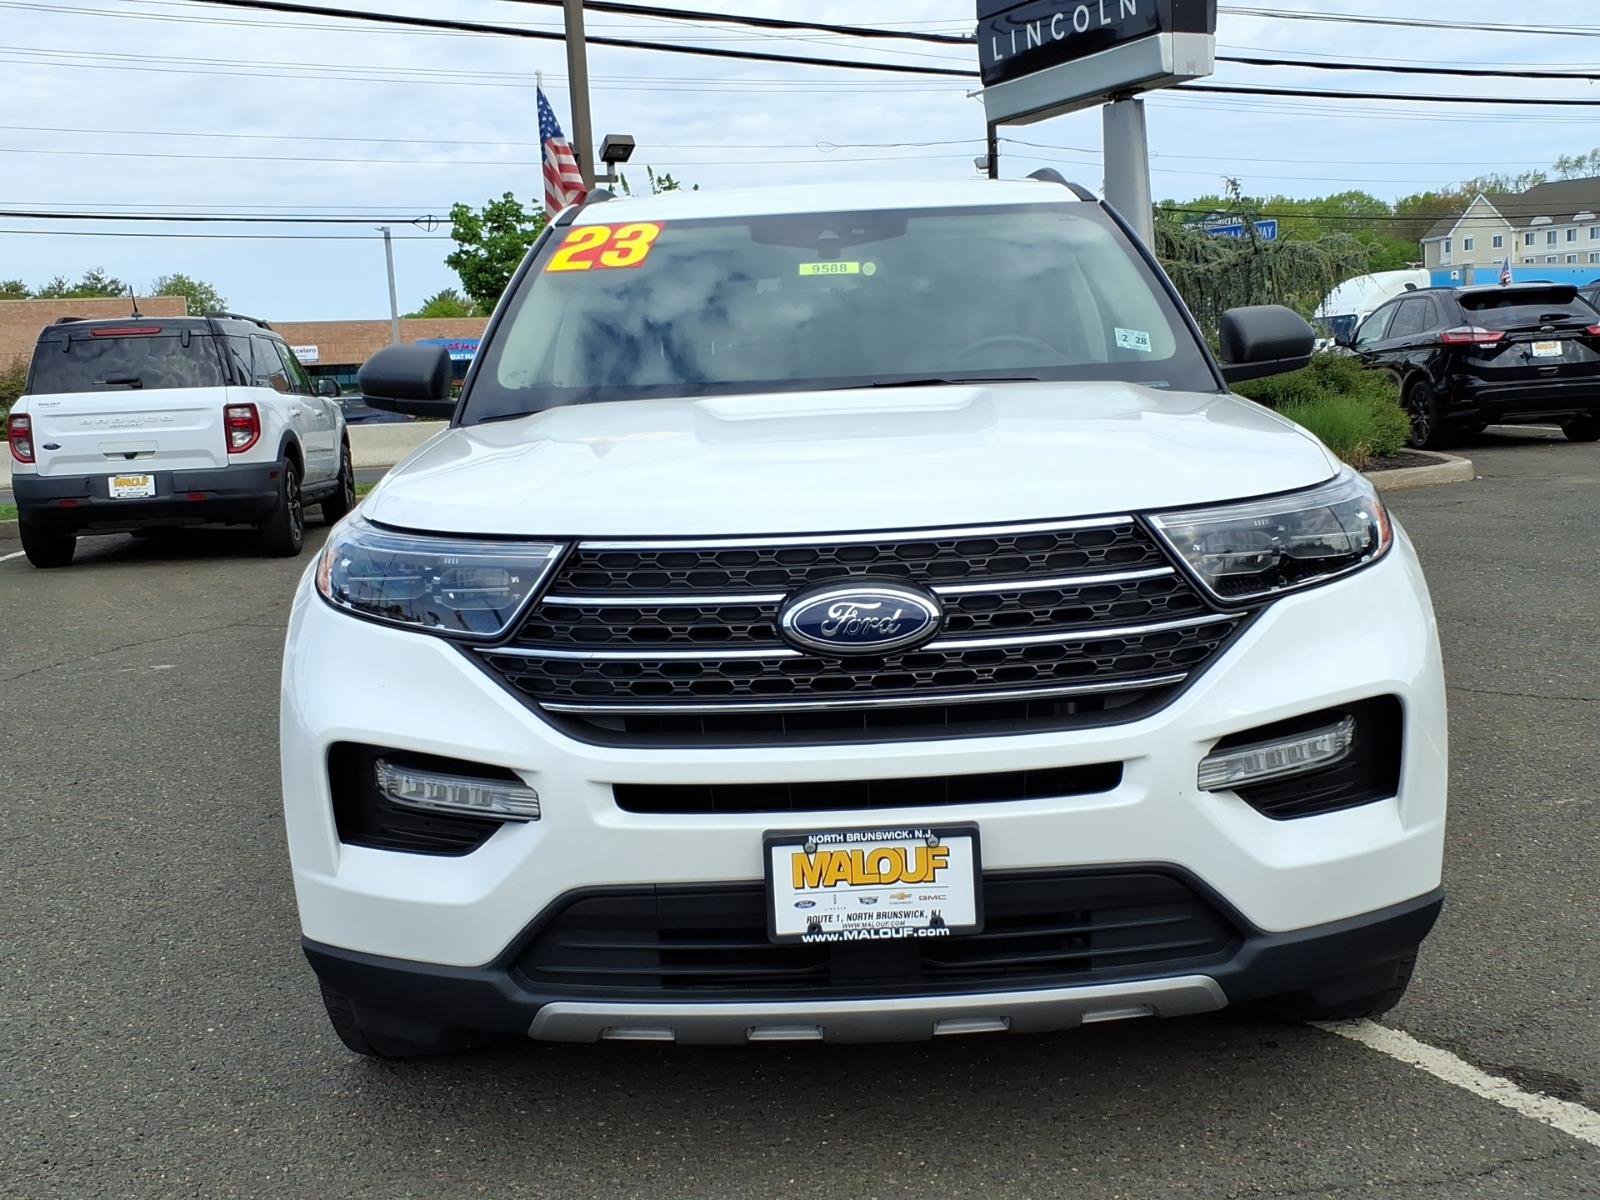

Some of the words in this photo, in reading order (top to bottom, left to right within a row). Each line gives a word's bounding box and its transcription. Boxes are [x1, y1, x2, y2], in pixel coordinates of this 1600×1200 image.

[992, 0, 1137, 62] LINCOLN
[546, 223, 660, 272] 23
[811, 263, 849, 274] 9588
[1121, 334, 1129, 343] 2
[1135, 336, 1147, 346] 28
[821, 601, 903, 636] Ford
[808, 834, 844, 844] NORTH
[791, 845, 950, 890] MALOUF
[806, 913, 834, 924] ROUTE
[846, 911, 875, 922] NORTH
[876, 909, 928, 920] BRUNSWICK,
[801, 927, 950, 943] www.MALOUF.com
